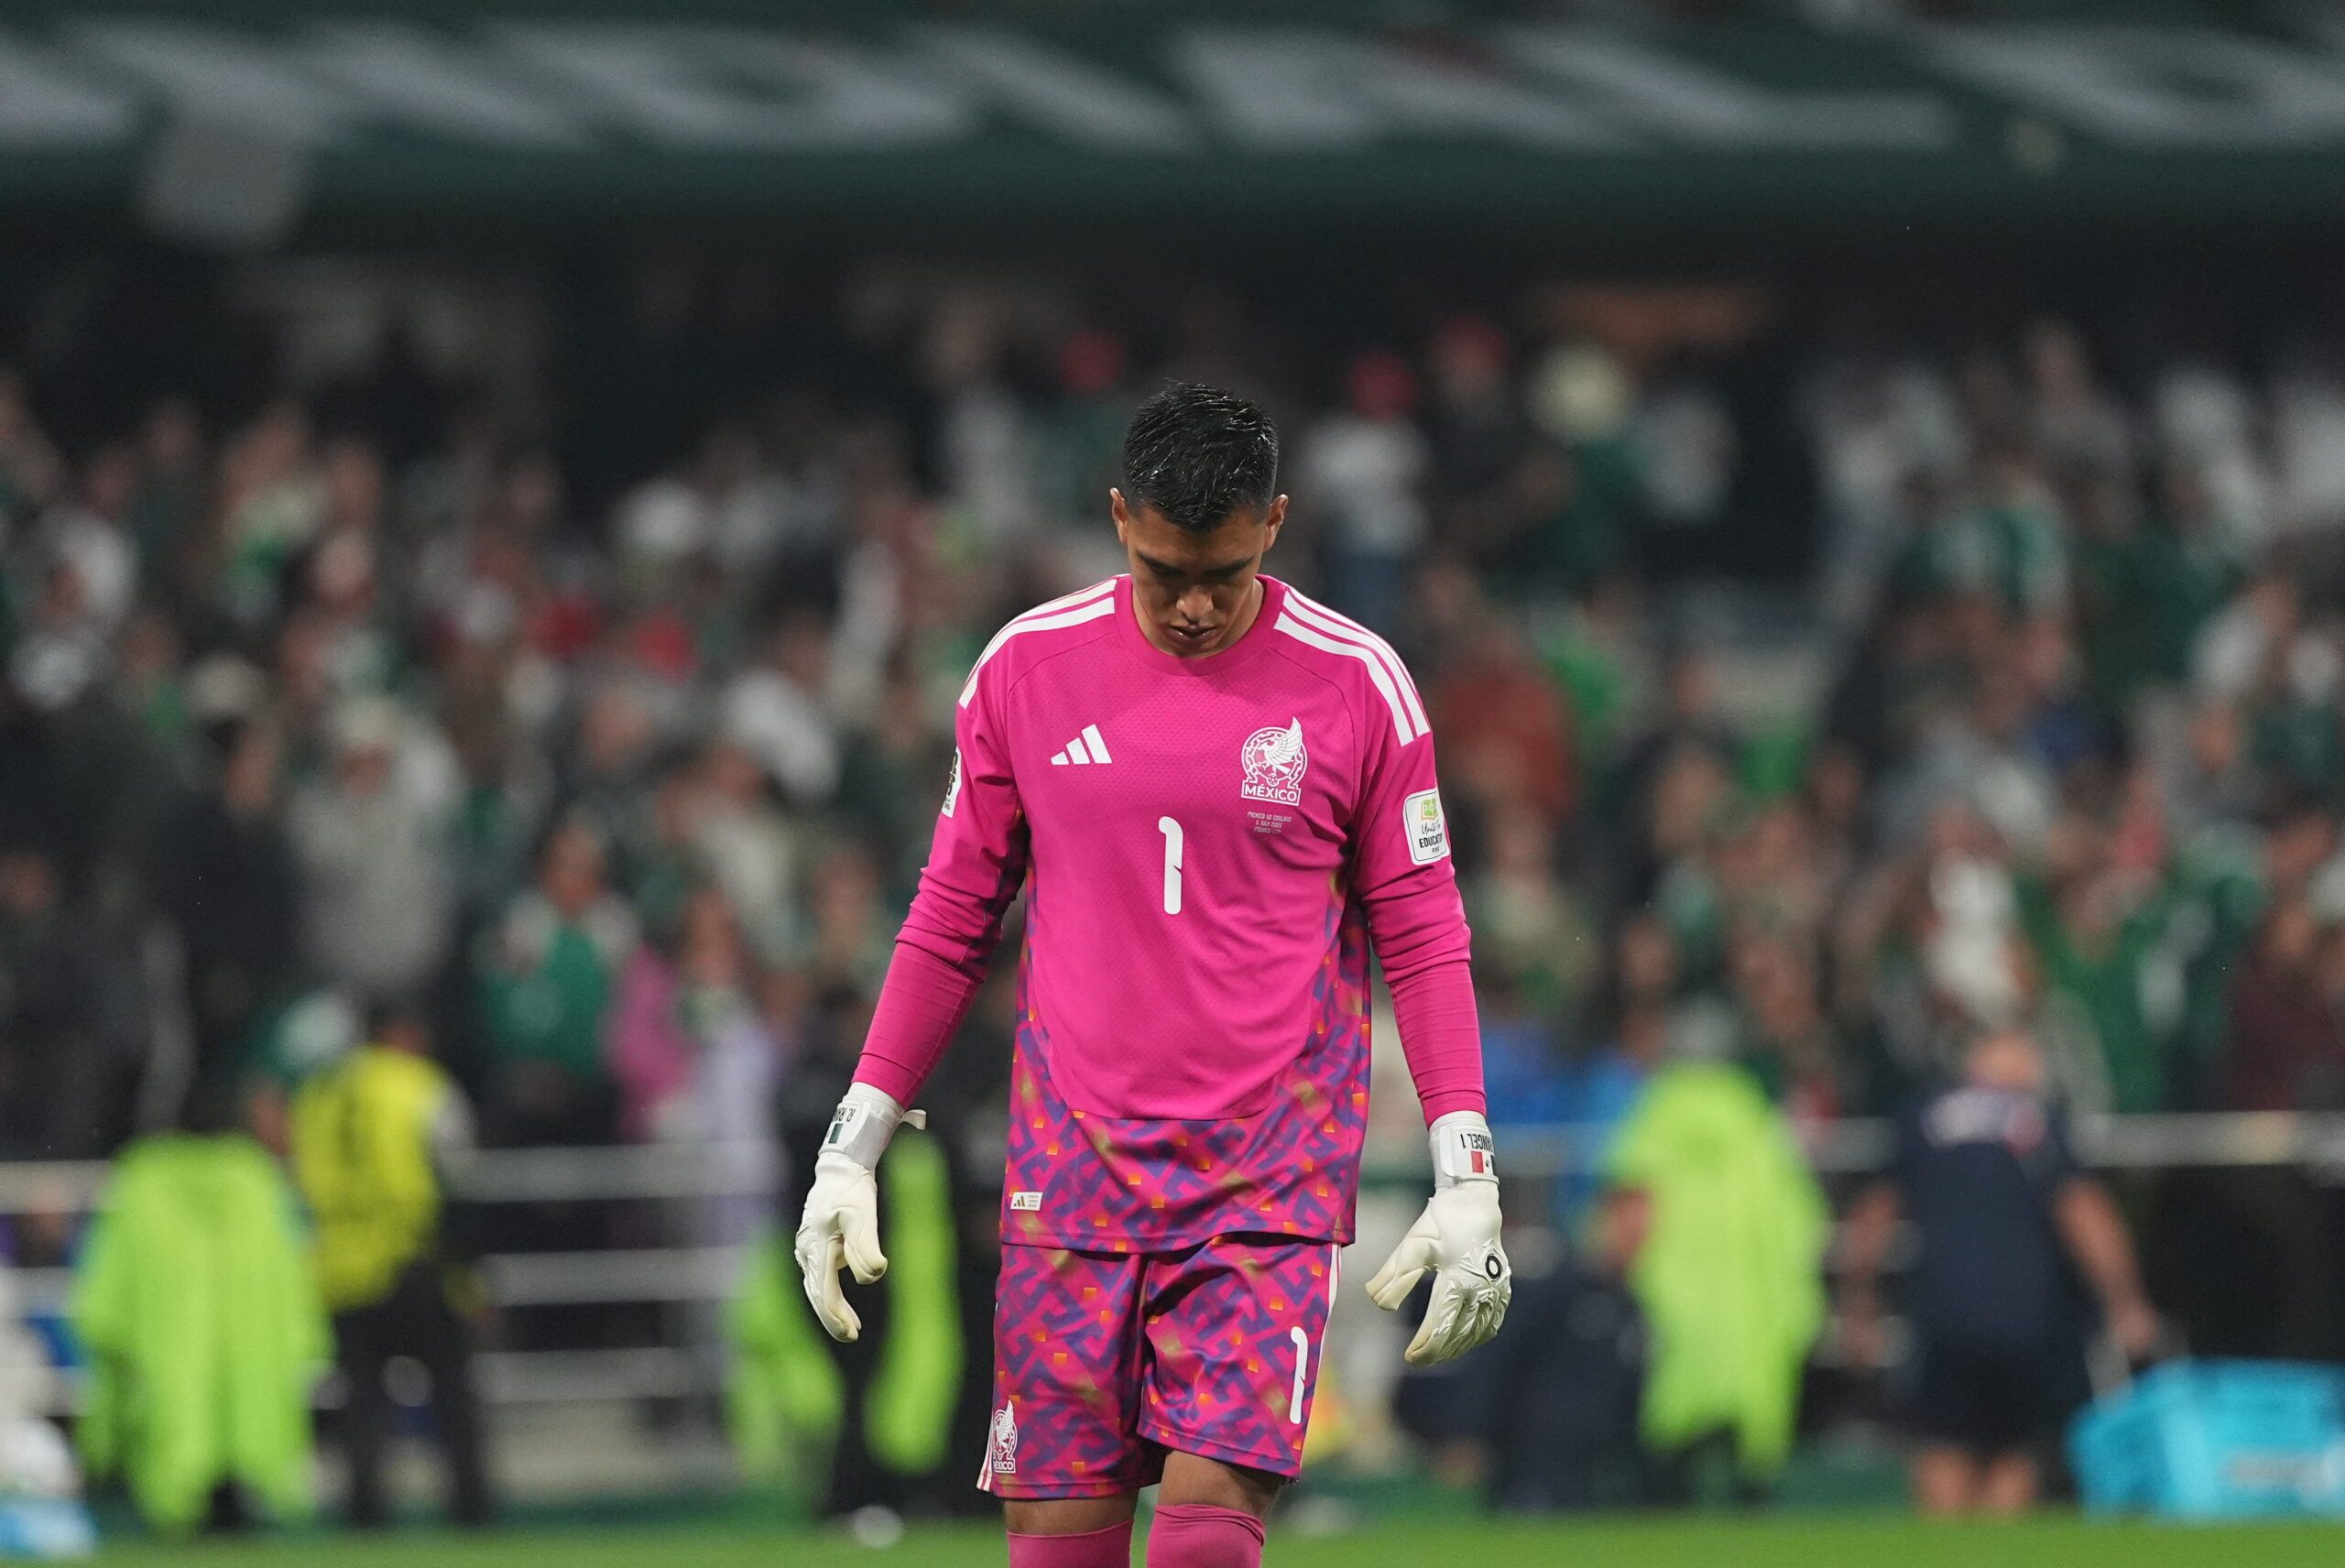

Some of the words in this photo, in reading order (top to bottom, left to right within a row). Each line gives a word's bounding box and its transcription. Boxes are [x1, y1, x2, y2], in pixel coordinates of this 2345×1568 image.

[1245, 783, 1297, 801] MÉXICO
[1158, 815, 1183, 915] 1
[1289, 1325, 1309, 1425] 1
